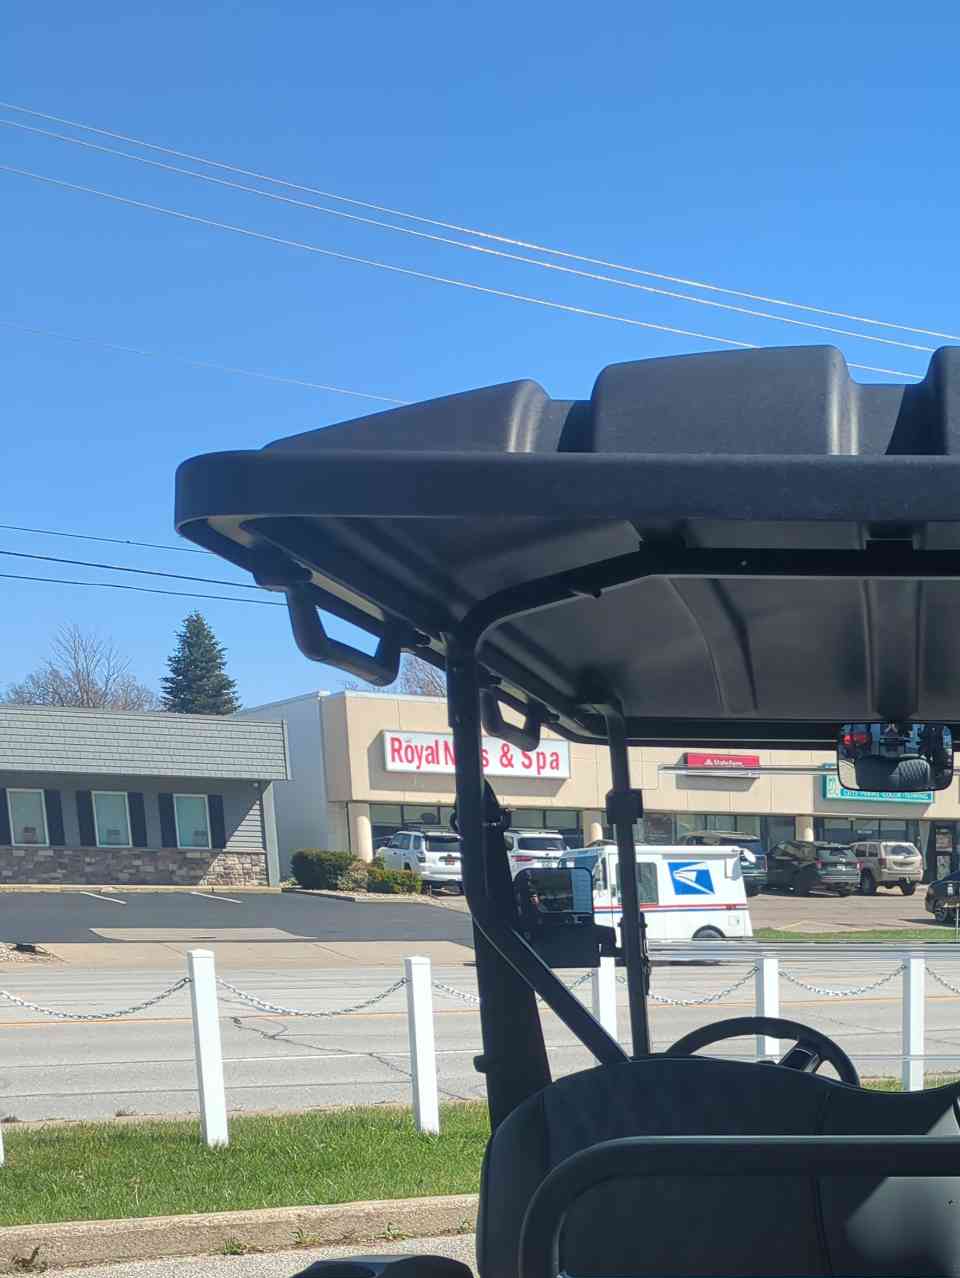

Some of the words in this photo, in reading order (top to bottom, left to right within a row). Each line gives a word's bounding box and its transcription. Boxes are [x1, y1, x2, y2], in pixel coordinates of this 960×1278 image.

[390, 737, 440, 770] Royal
[500, 743, 514, 768] &
[521, 750, 559, 775] Spa
